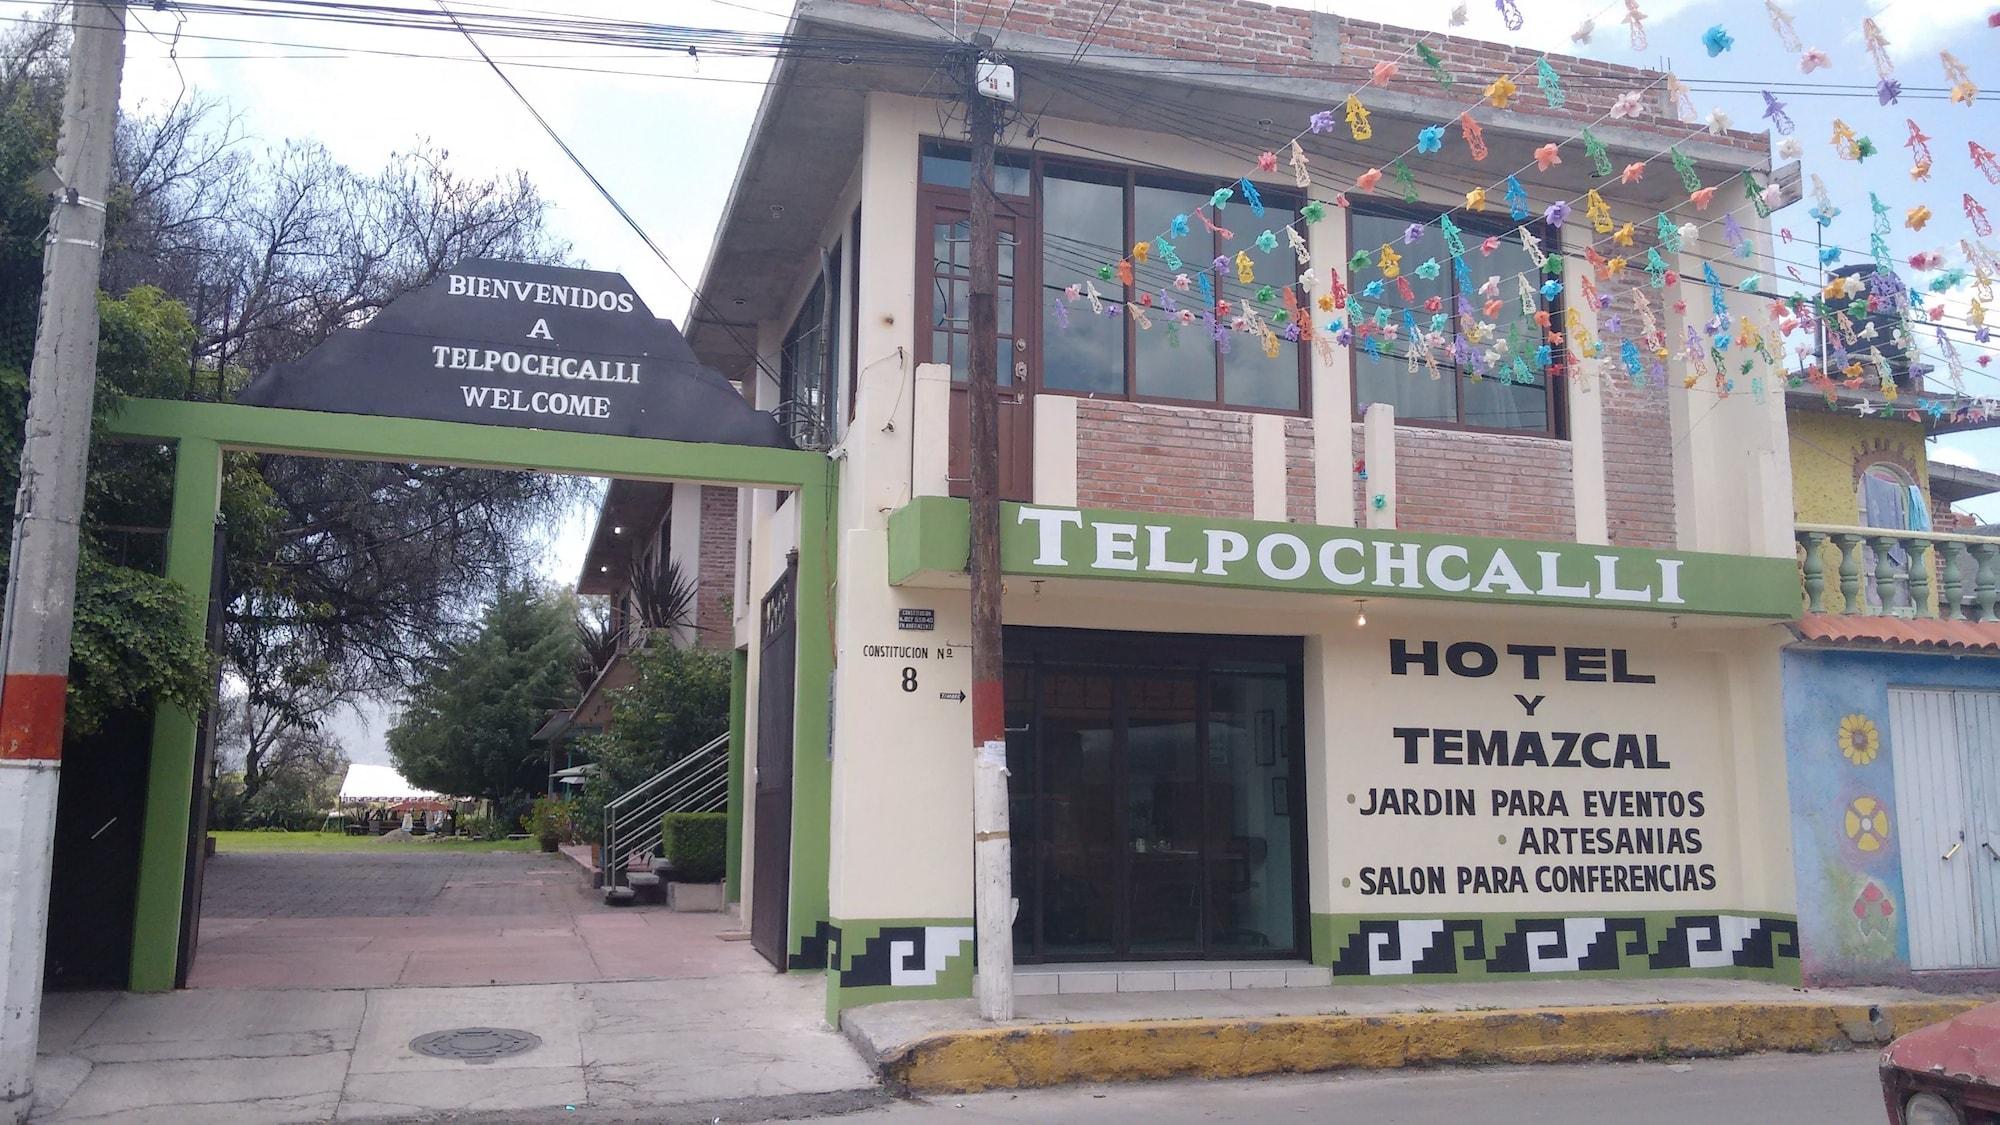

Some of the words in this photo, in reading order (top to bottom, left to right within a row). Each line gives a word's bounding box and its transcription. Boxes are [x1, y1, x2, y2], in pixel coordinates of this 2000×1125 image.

[448, 274, 634, 313] BIENVENIDOS
[526, 318, 554, 340] A
[432, 345, 641, 384] TELPOCHCALLI
[460, 386, 611, 418] WELCOME
[1017, 506, 1685, 603] TELPOCHCALLI
[863, 645, 928, 659] CONSTITUCION
[1389, 639, 1656, 684] HOTEL
[901, 667, 918, 692] 8
[1514, 694, 1546, 716] Y
[1393, 727, 1671, 769] TEMAZCAL
[1359, 788, 1476, 816] JARDIN
[1491, 789, 1569, 817] PARA
[1583, 790, 1705, 818] EVENTOS
[1518, 827, 1703, 855] ARTESANIAS
[1359, 866, 1445, 895] SALON
[1457, 866, 1528, 894] PARA
[1535, 864, 1717, 893] CONFERENCIAS
